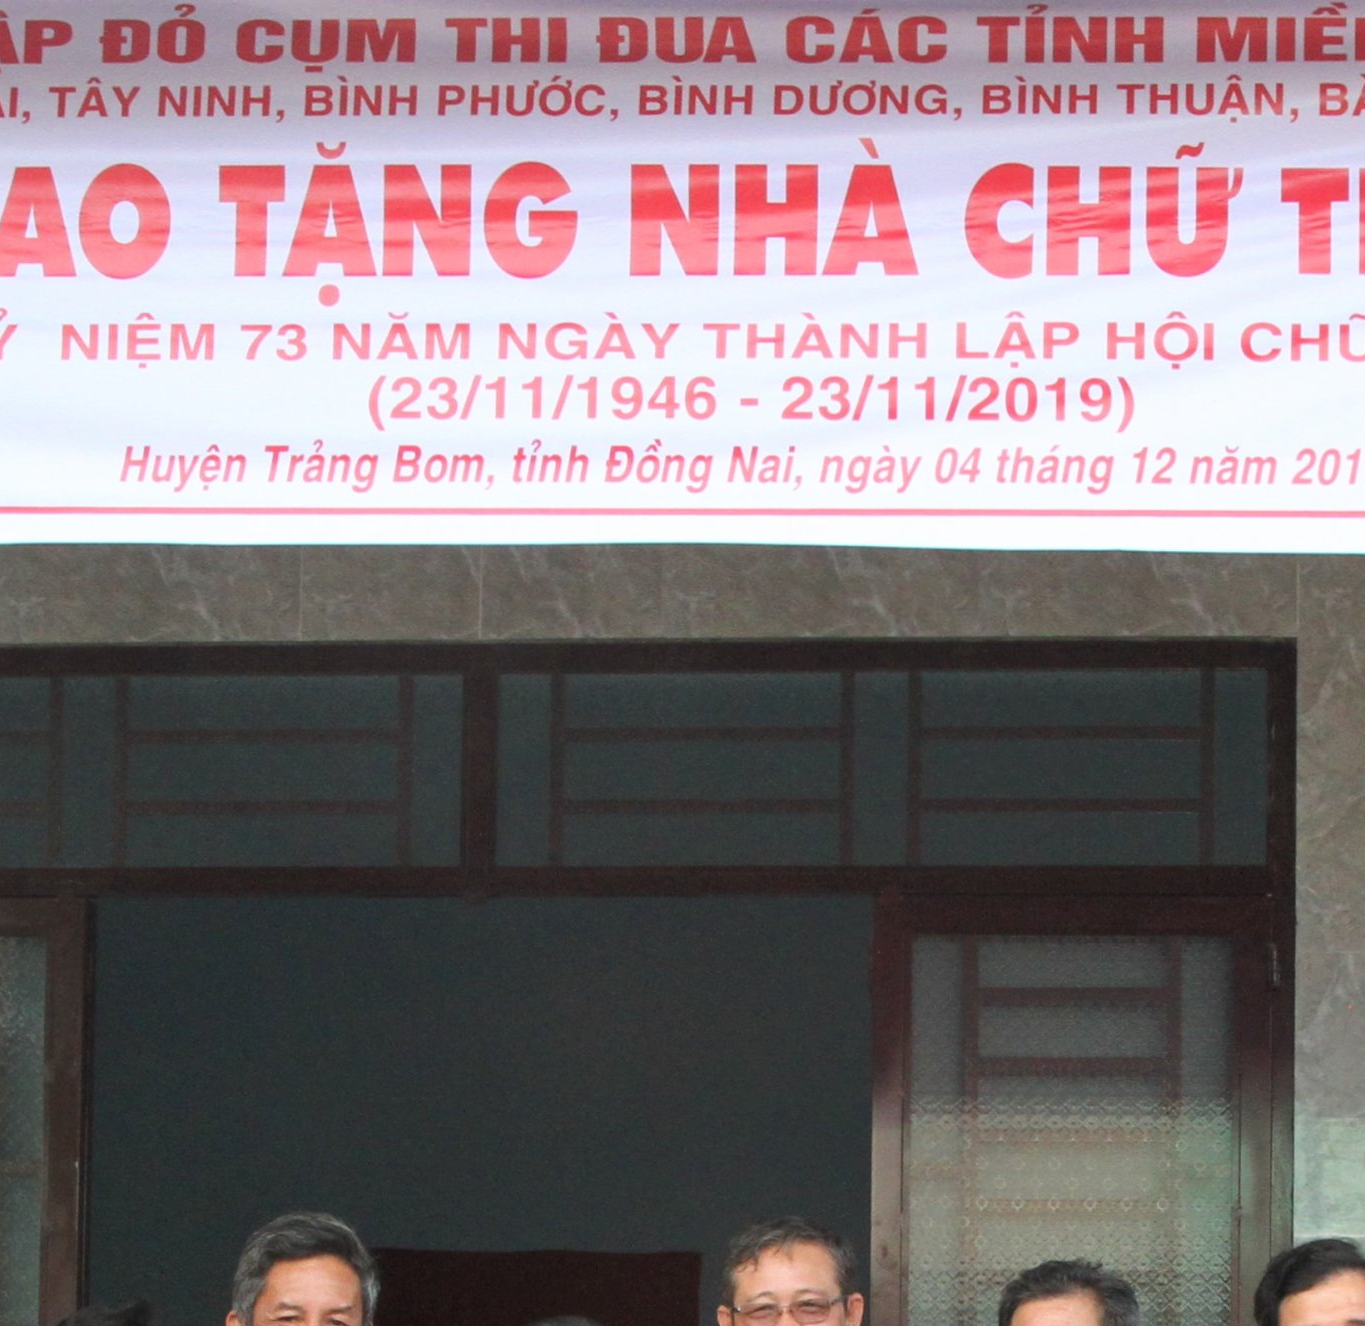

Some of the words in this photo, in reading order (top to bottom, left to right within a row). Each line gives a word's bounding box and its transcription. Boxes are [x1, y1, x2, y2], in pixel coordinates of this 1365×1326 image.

[100, 5, 207, 64] ĐỎ
[236, 18, 417, 74] CỤM
[445, 17, 569, 64] THI
[596, 16, 757, 64] ĐUA
[786, 9, 948, 64] CÁC
[976, 4, 1166, 64] TỈNH
[49, 78, 140, 118] TÂY
[158, 85, 286, 120] NINH,
[304, 77, 418, 117] BÌNH
[438, 75, 619, 119] PHƯỚC,
[638, 76, 754, 116] BÌNH
[773, 80, 963, 119] DƯƠNG,
[982, 77, 1099, 116] BÌNH
[1116, 74, 1299, 124] THUẬN,
[219, 142, 579, 307] TẶNG
[630, 138, 918, 277] NHÀ
[964, 143, 1244, 279] CHỮ
[62, 313, 215, 368] NIỆM
[241, 324, 307, 361] 73
[333, 313, 471, 360] NĂM
[499, 312, 679, 360] NGÀY
[703, 313, 927, 359] THÀNH
[956, 311, 1080, 368] LẬP
[1107, 311, 1214, 370] HỘI
[369, 375, 716, 431] (23/11/1946
[740, 398, 759, 406] -
[782, 375, 1134, 432] 23/11/2019)
[121, 444, 247, 492] Huyện
[265, 440, 379, 493] Trảng
[394, 445, 494, 484] Bom,
[513, 440, 589, 483] tỉnh
[605, 439, 713, 493] Đồng
[728, 446, 802, 490] Nai,
[821, 447, 921, 494] ngày
[936, 448, 981, 483] 04
[997, 448, 1114, 495] tháng
[1133, 448, 1176, 484] 12
[1191, 449, 1277, 484] năm
